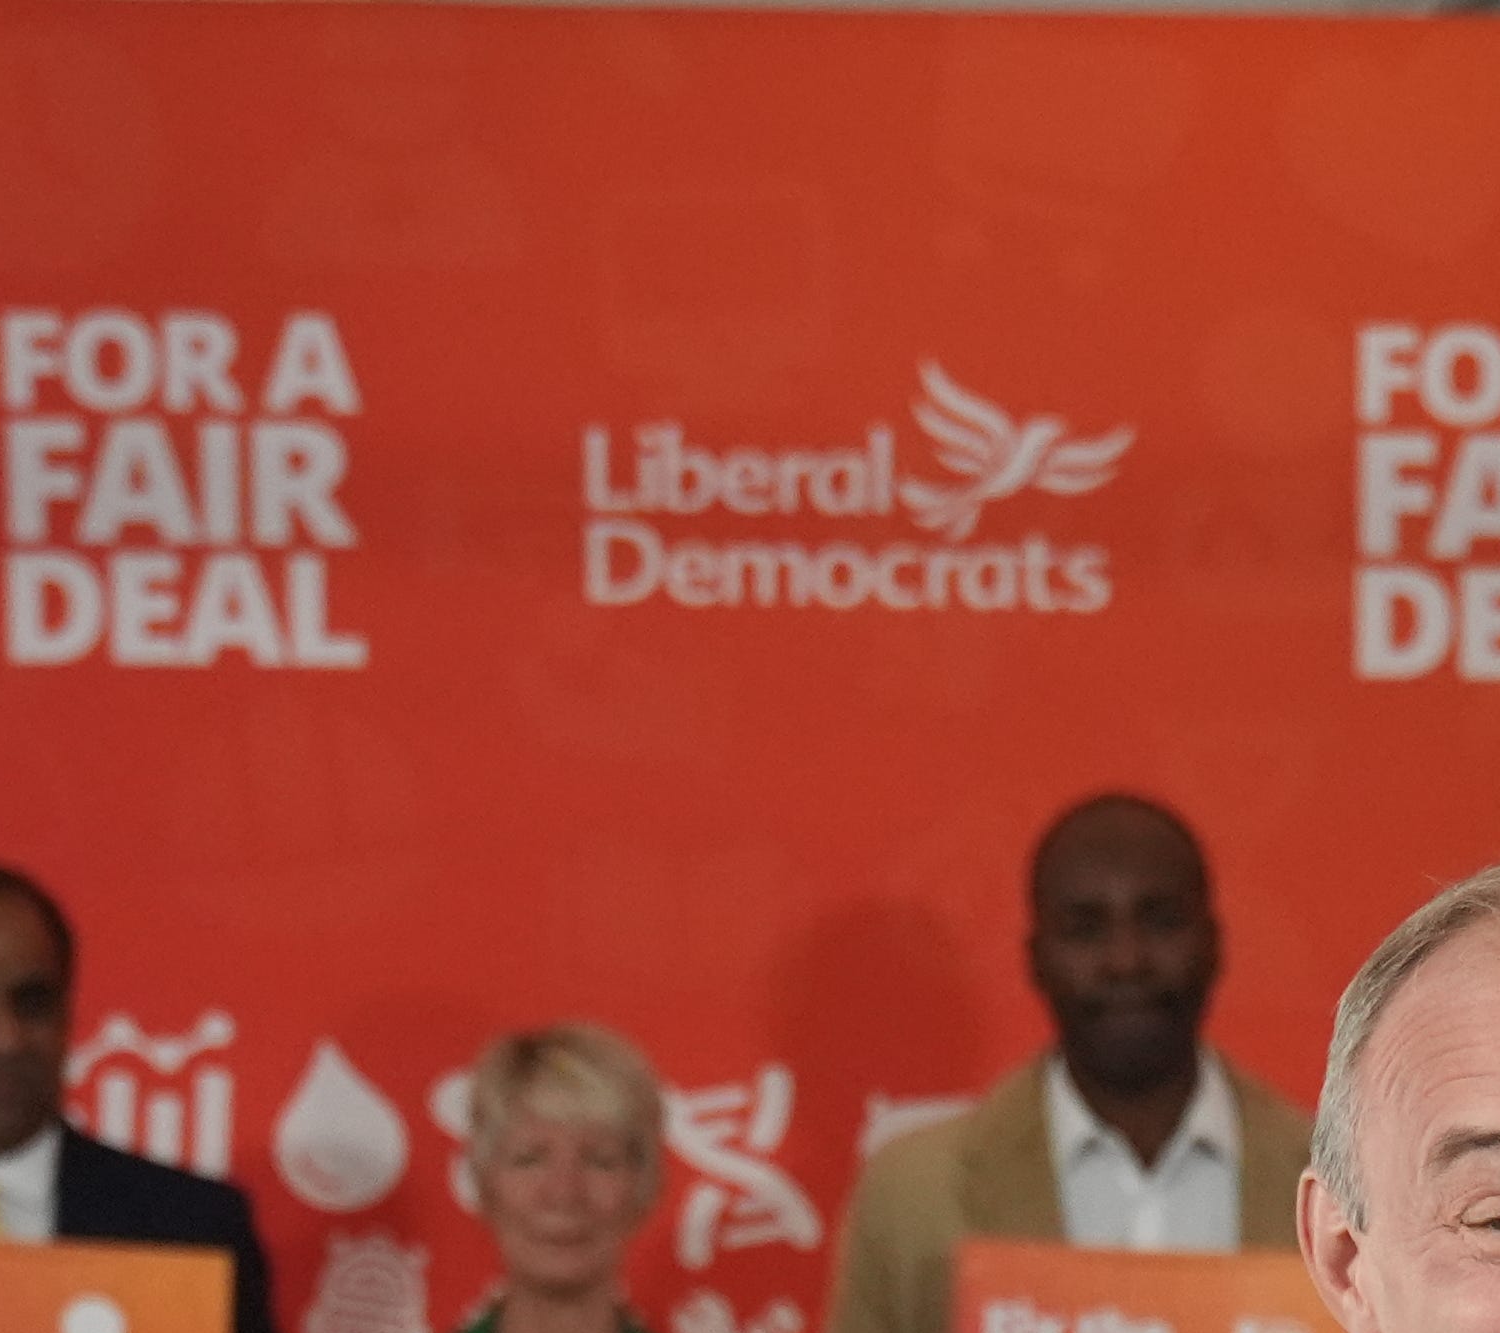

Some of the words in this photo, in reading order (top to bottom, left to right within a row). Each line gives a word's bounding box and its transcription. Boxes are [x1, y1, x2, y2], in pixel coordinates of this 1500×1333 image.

[0, 310, 244, 413] FOR
[263, 311, 362, 415] A
[3, 415, 359, 547] FAIR
[584, 423, 895, 516] Liberal
[4, 550, 369, 669] DEAL
[585, 521, 1111, 611] Democrats
